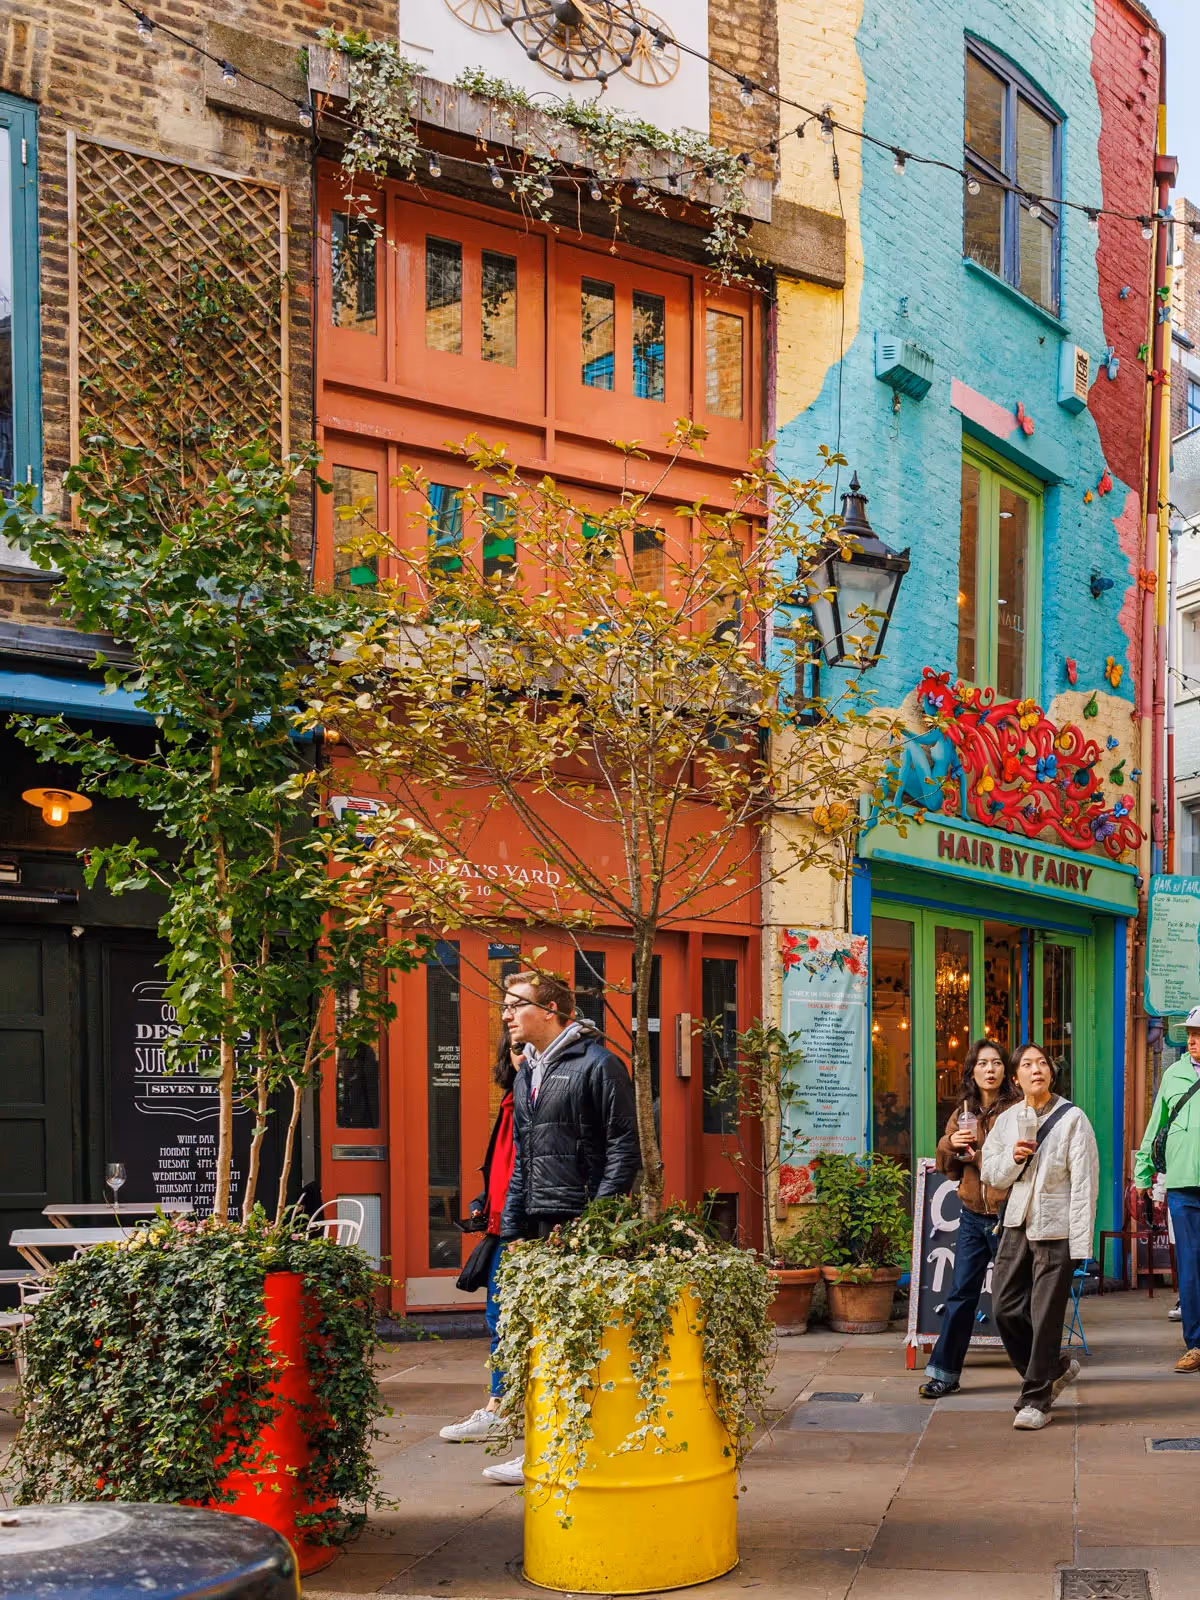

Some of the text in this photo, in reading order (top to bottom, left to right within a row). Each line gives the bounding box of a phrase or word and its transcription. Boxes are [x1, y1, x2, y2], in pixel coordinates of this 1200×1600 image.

[938, 830, 1093, 891] HAIR BY FAIRY
[504, 864, 560, 885] YARD
[1154, 876, 1172, 894] HAIR
[476, 884, 491, 896] 10
[151, 1085, 195, 1094] SEVEN
[177, 1134, 215, 1144] WINE BAR
[160, 1147, 190, 1156] MONDAY
[158, 1160, 190, 1168] TUESDAY
[152, 1172, 196, 1180] WEDNESDAY
[156, 1184, 192, 1193] THURSDAY
